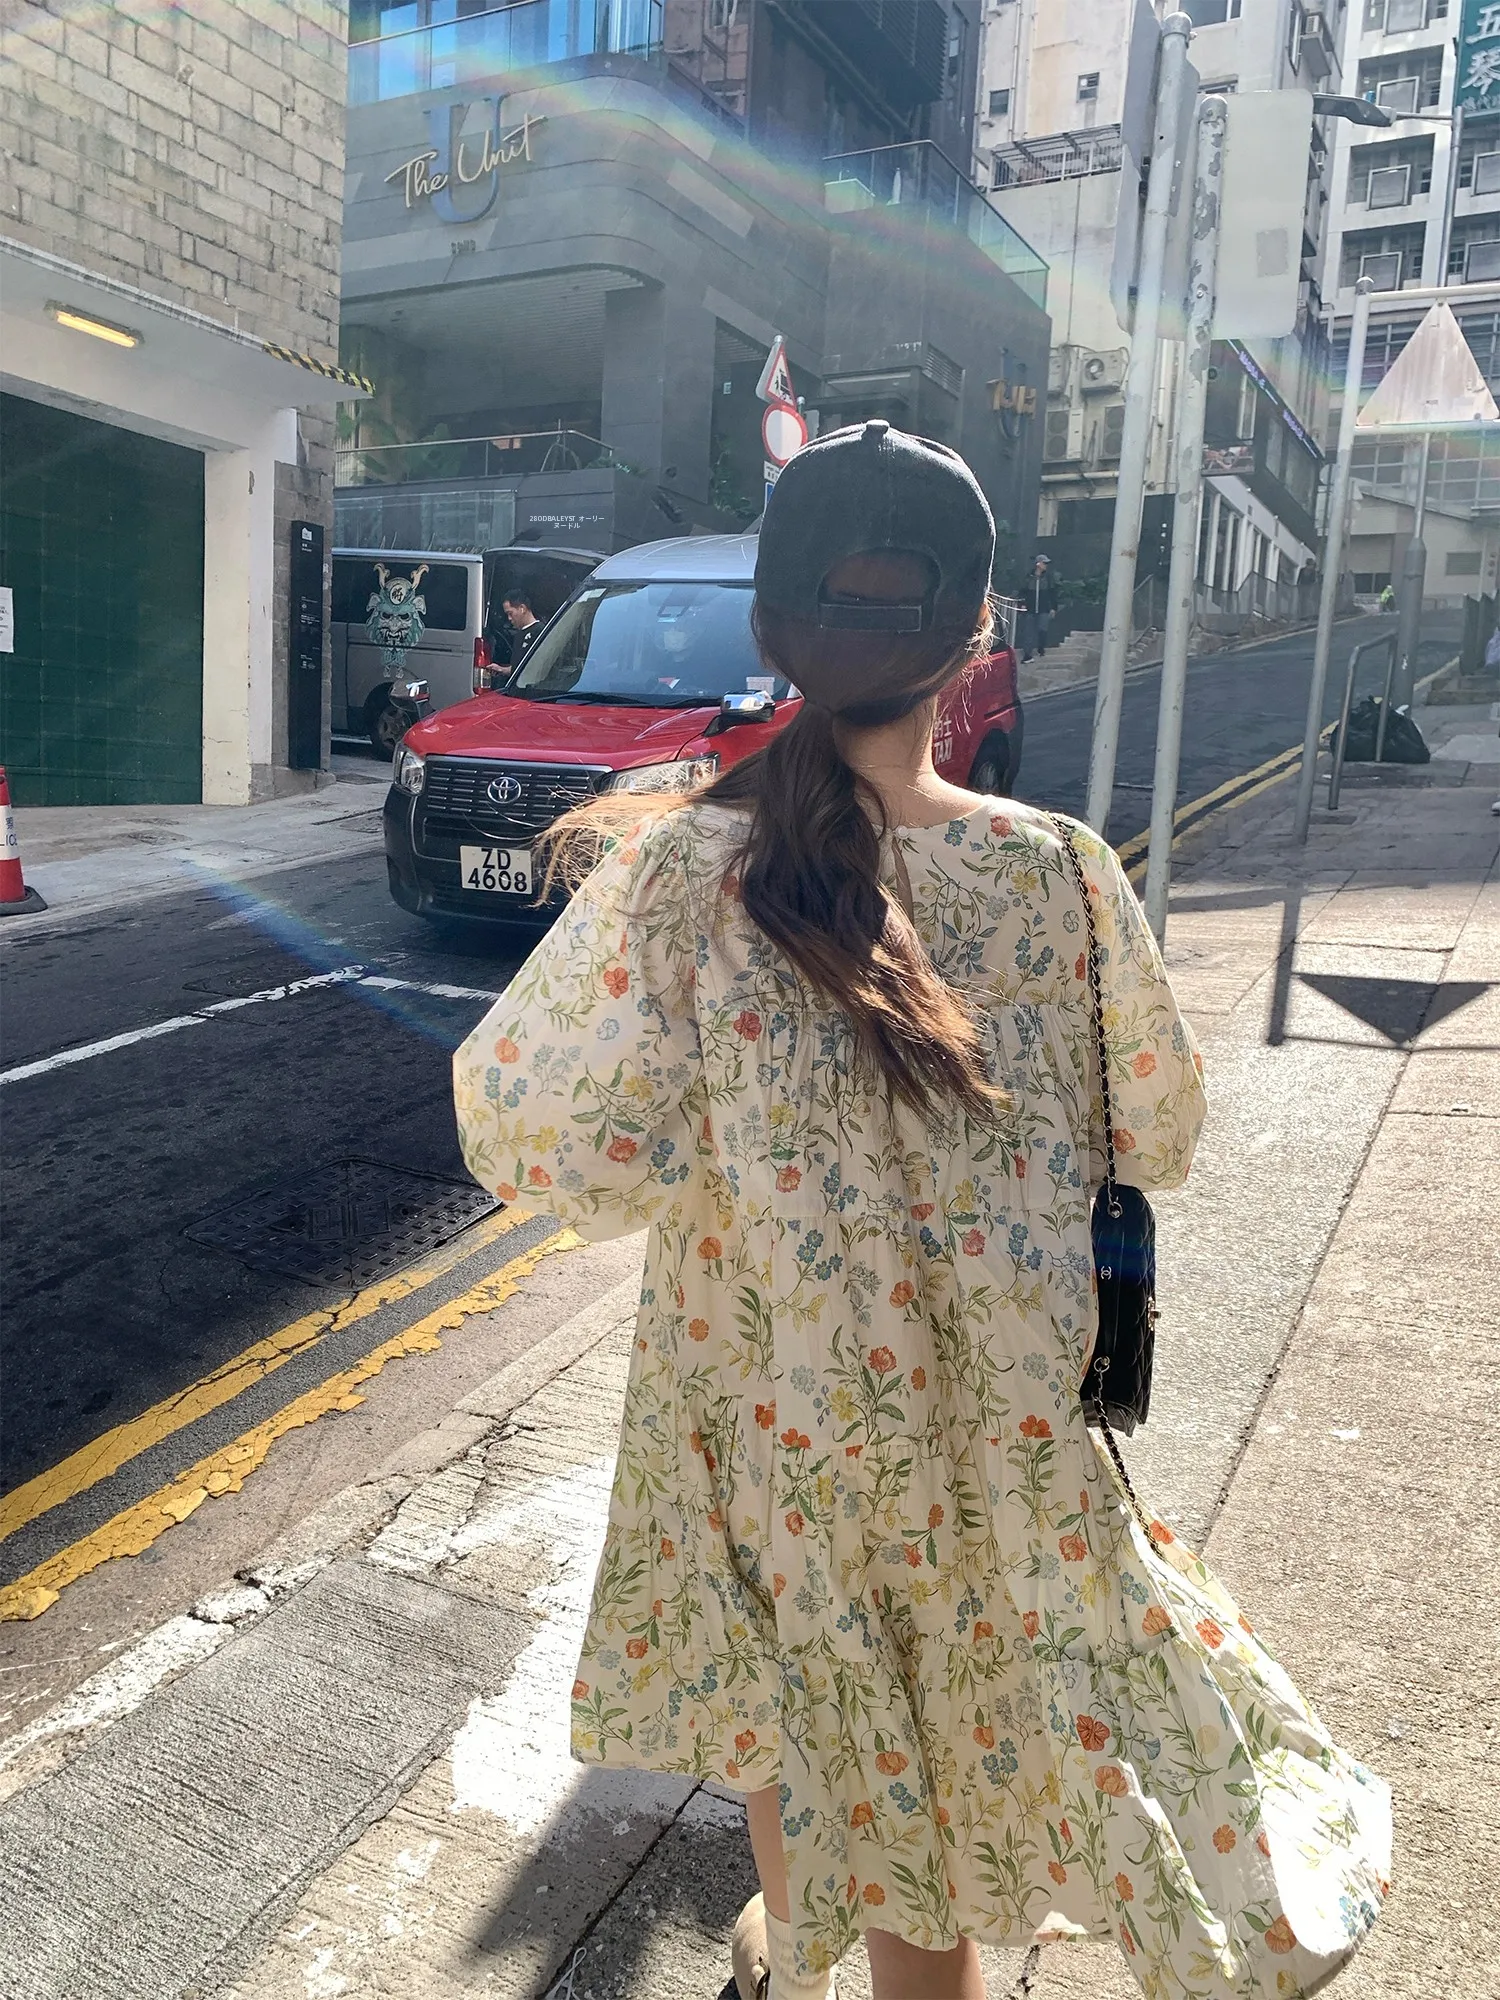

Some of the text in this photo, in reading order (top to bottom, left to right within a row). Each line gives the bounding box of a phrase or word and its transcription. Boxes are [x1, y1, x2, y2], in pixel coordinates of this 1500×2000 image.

[384, 112, 547, 208] The Unit
[553, 522, 581, 530] ヌードル
[934, 737, 953, 766] TAXI
[481, 848, 511, 870] ZD
[468, 867, 527, 892] 4608
